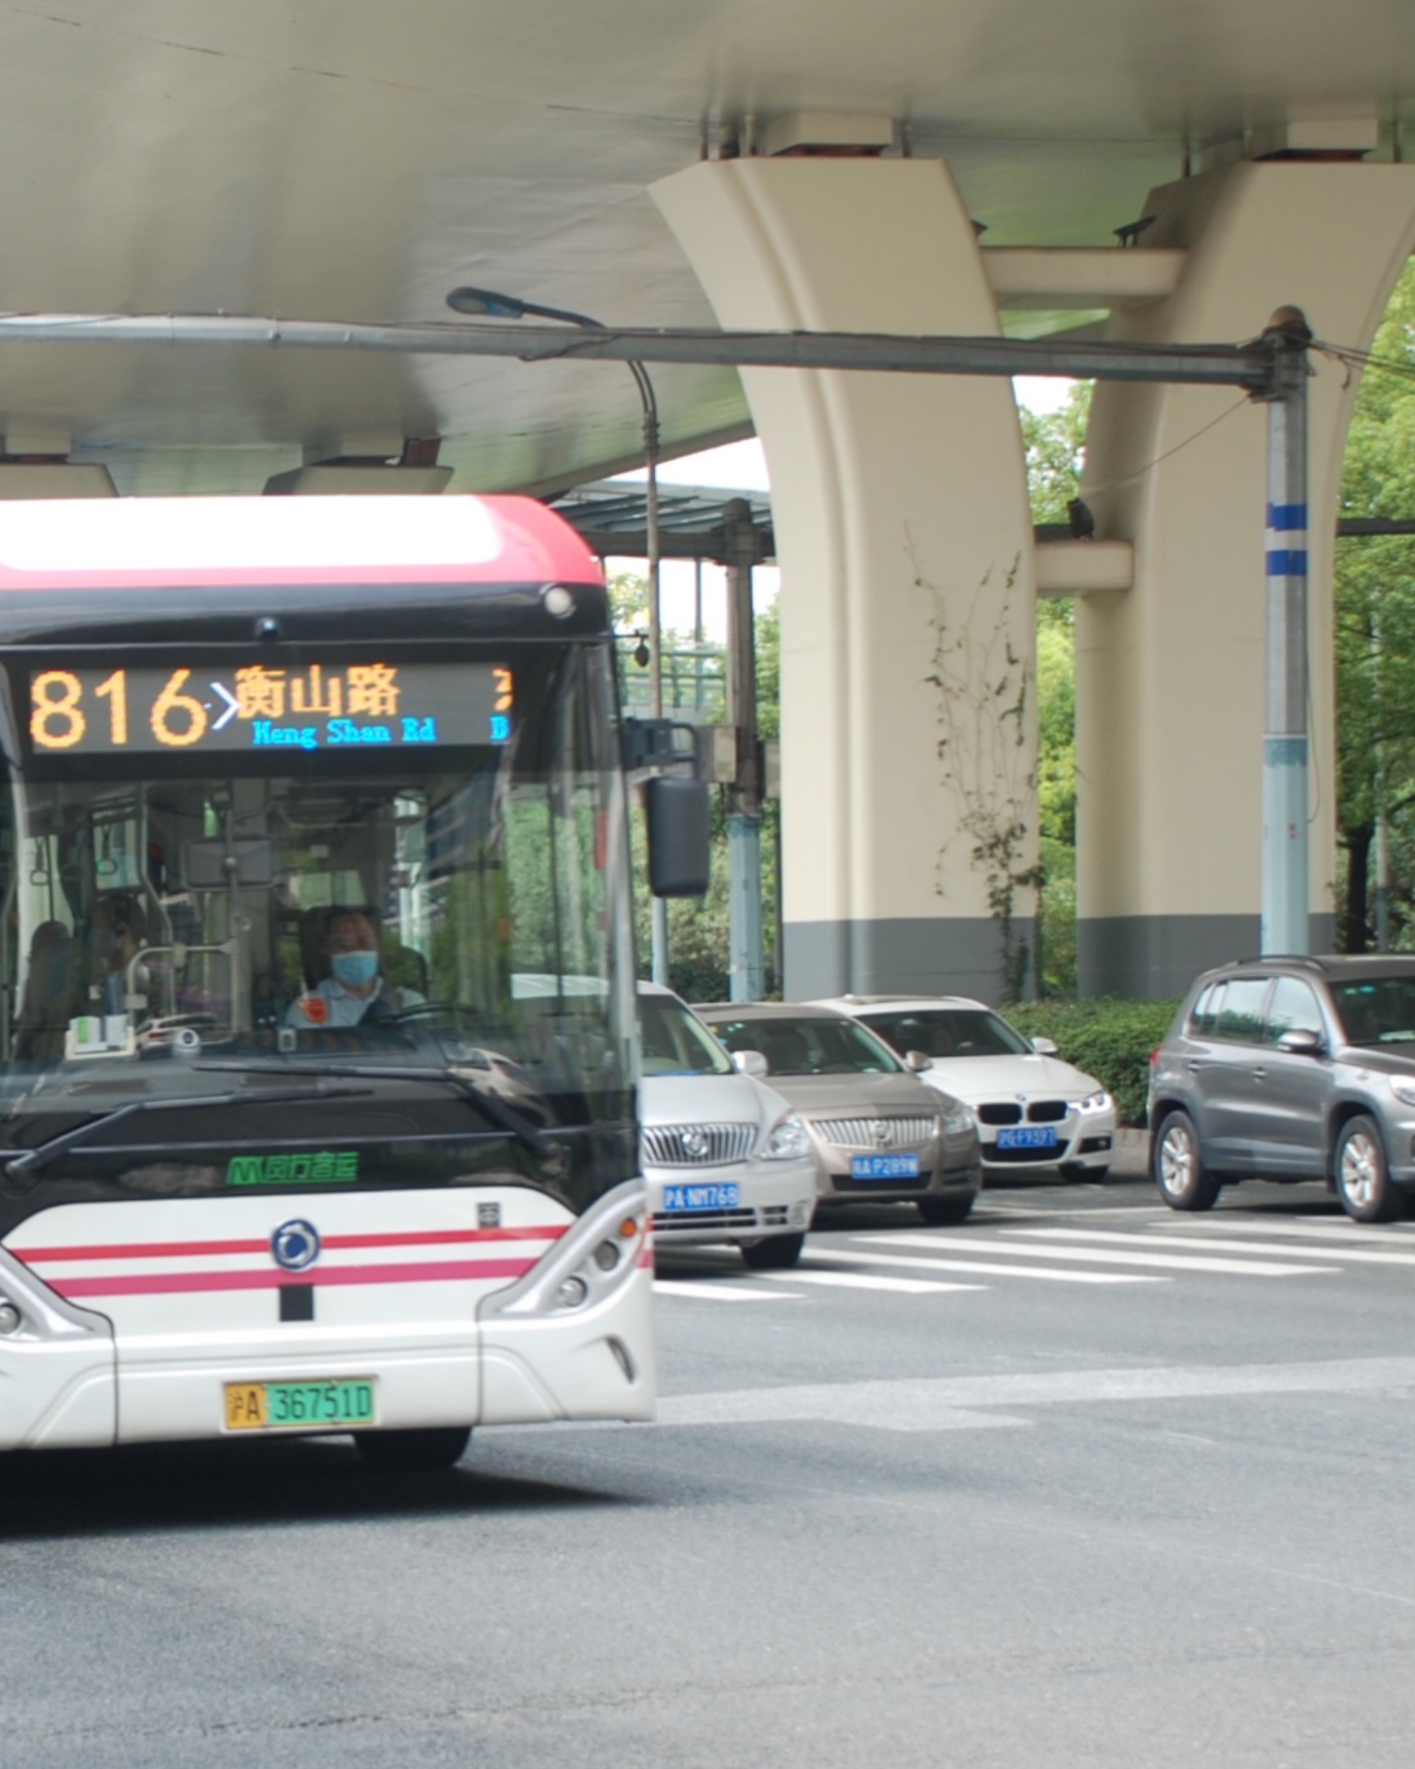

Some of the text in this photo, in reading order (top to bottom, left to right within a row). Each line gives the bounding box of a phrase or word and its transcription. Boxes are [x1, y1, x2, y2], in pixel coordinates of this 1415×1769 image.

[30, 669, 208, 748] 816
[234, 663, 402, 719] 衡山路
[252, 716, 436, 749] Heng Shan Rd
[275, 1386, 371, 1420] 36751D
